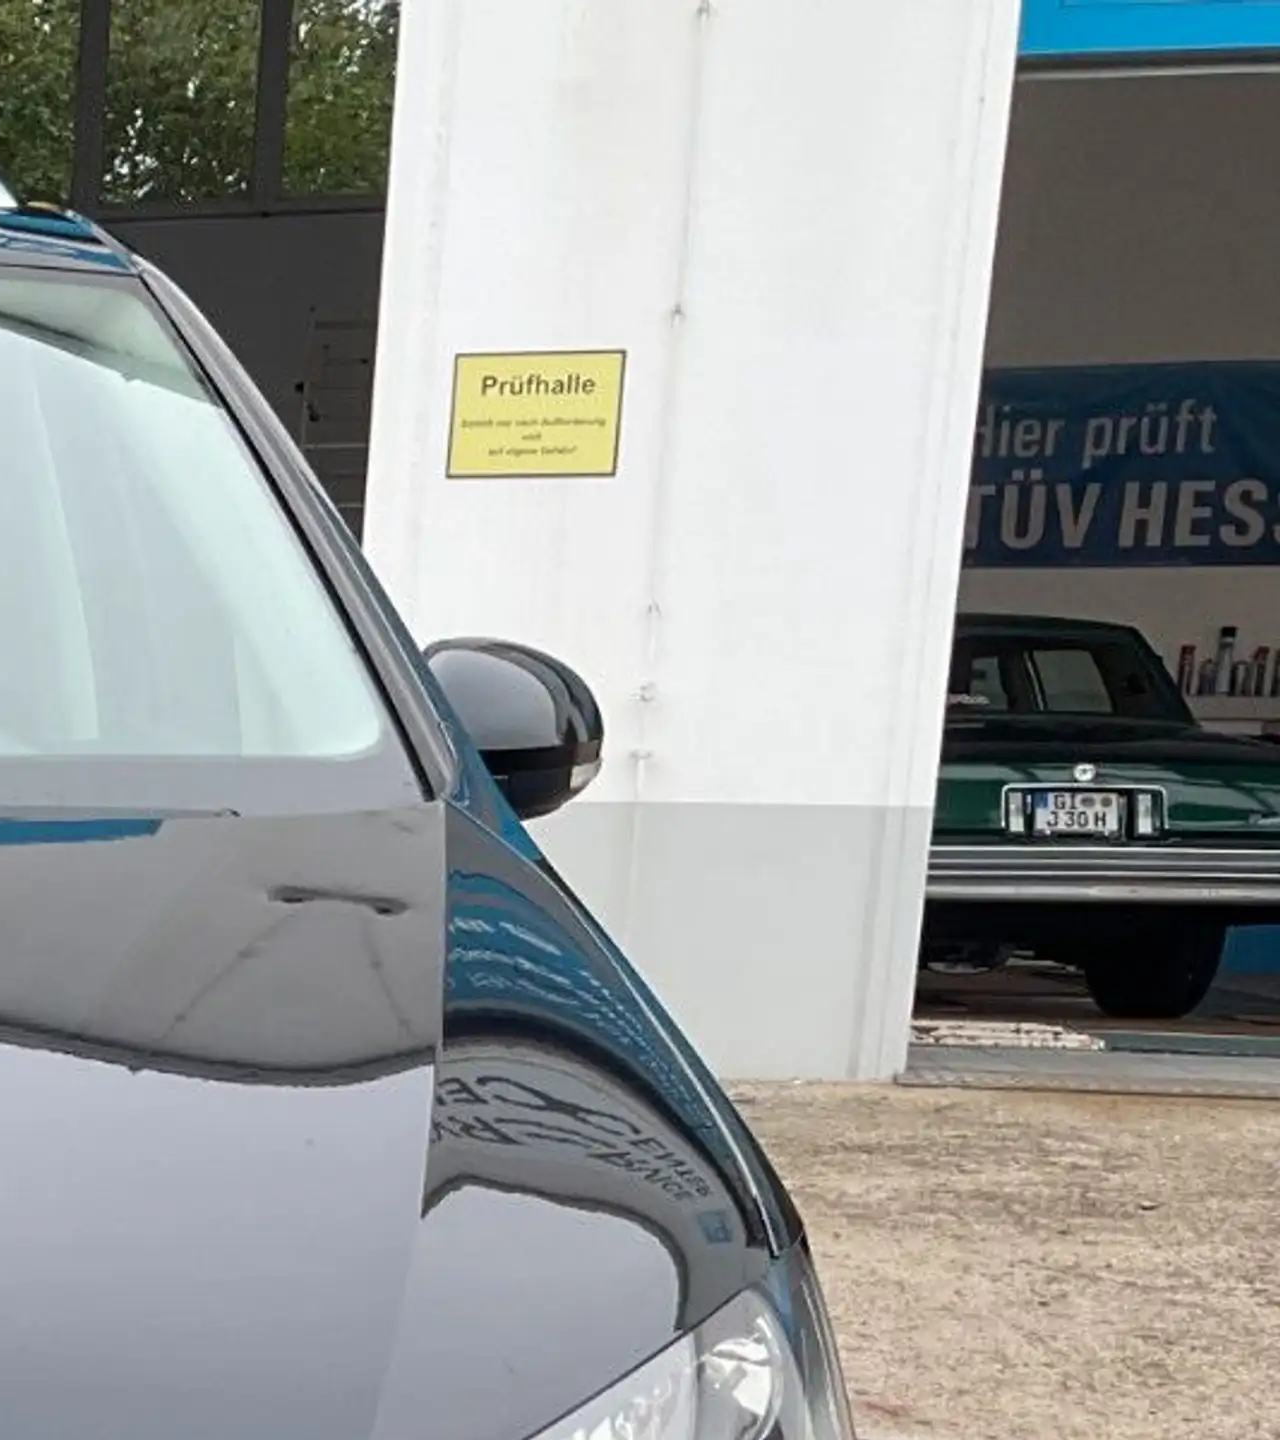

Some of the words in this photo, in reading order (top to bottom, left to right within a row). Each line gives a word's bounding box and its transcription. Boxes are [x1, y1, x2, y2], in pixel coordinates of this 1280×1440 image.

[480, 373, 596, 397] Prüfhalle
[1082, 399, 1217, 470] prüft
[964, 468, 1102, 549] TÜV
[1117, 478, 1280, 549] HES
[1053, 793, 1077, 810] GI
